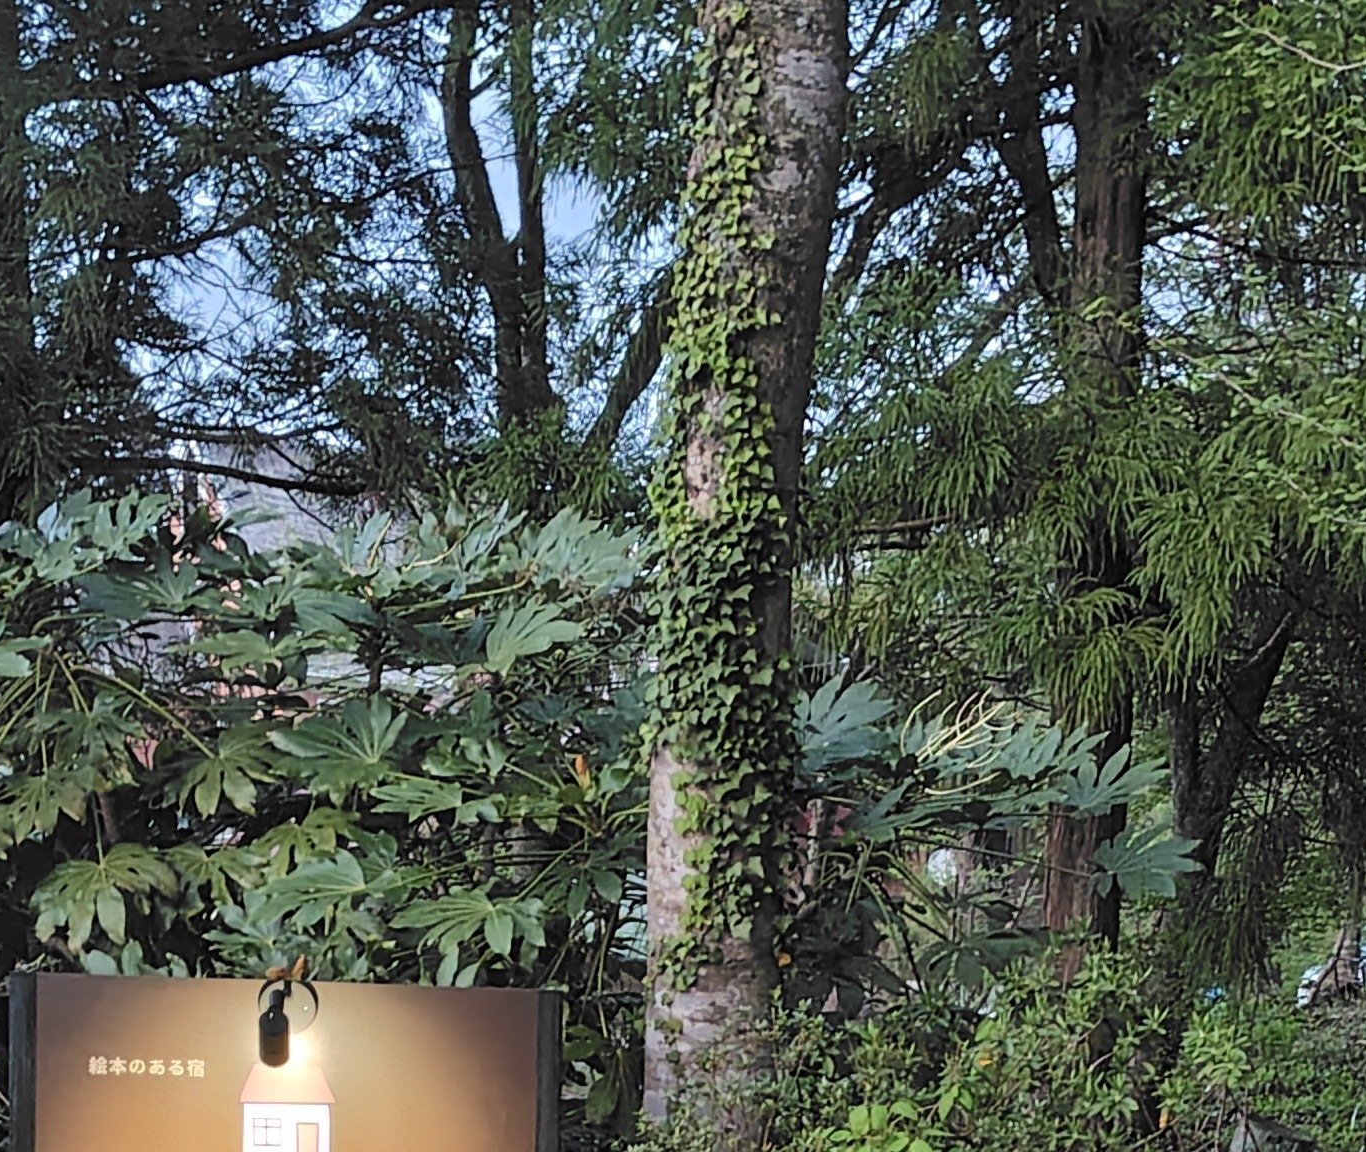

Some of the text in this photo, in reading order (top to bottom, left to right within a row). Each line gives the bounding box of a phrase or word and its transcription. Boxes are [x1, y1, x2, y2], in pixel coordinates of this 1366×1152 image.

[88, 1056, 205, 1078] 絵本のある宿
